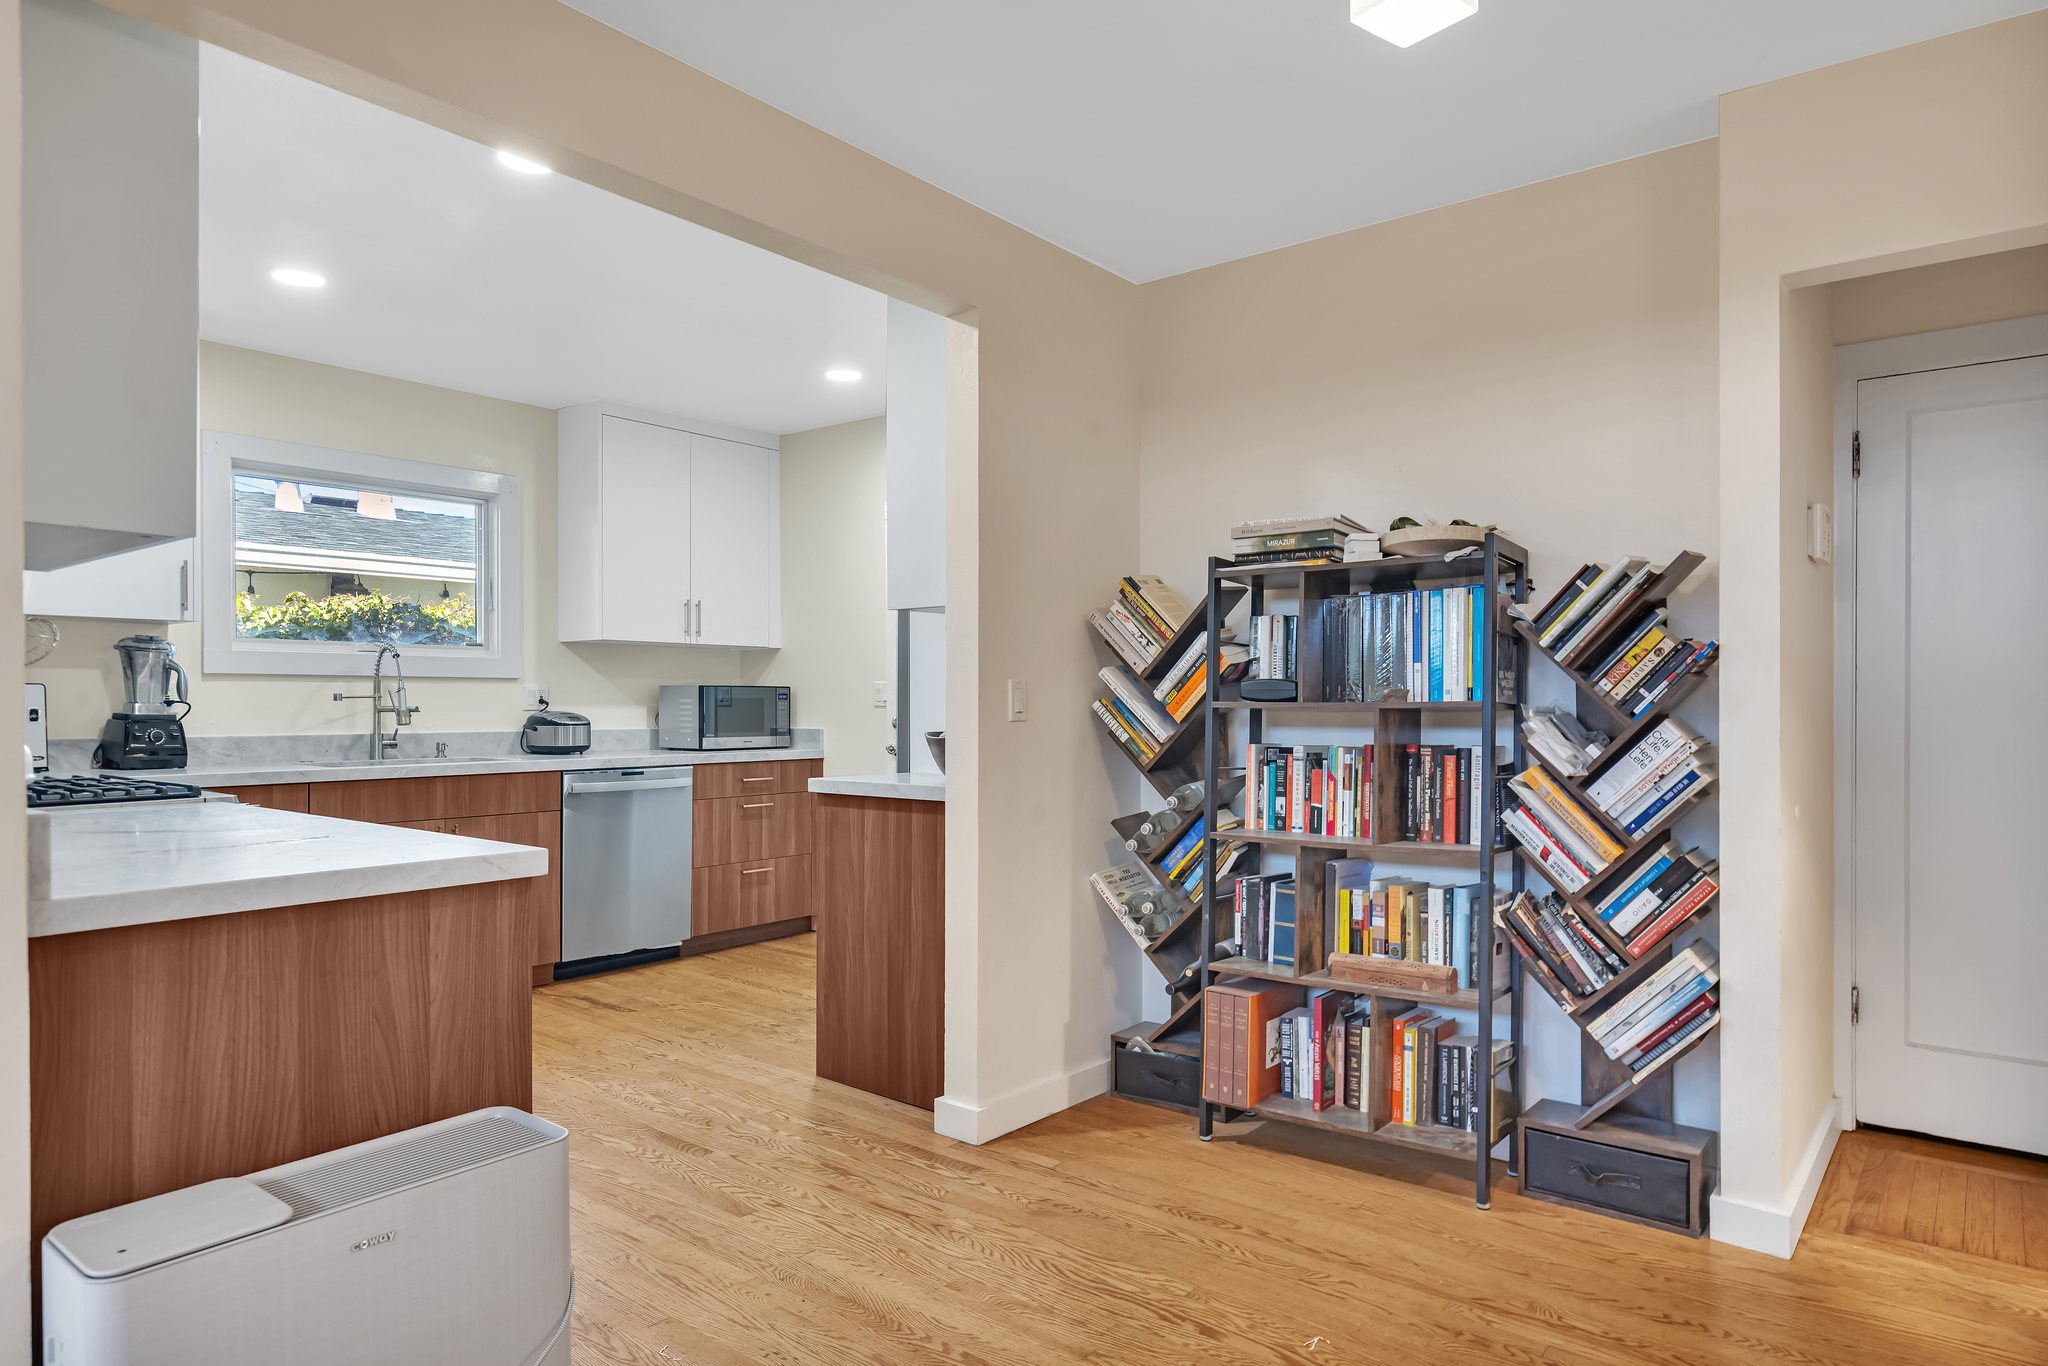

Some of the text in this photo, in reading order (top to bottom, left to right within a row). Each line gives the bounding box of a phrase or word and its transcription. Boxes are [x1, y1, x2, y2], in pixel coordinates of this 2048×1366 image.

[1266, 538, 1296, 546] MIRAZUR
[1597, 588, 1616, 606] California
[1607, 661, 1632, 684] KING
[1094, 704, 1126, 738] ORIGINS
[1628, 750, 1647, 770] Lefe
[1637, 744, 1654, 763] Hen
[1637, 755, 1680, 792] HUMAN SHIELDS
[1551, 796, 1583, 829] INTRODUCTION
[1548, 799, 1569, 820] PRACTICE
[1574, 825, 1599, 850] STATISTICS
[1097, 886, 1105, 895] THE
[1631, 897, 1651, 917] DALIO
[1661, 886, 1711, 930] BEFORE THE MOVEMENT
[1576, 923, 1604, 949] MALCOLM
